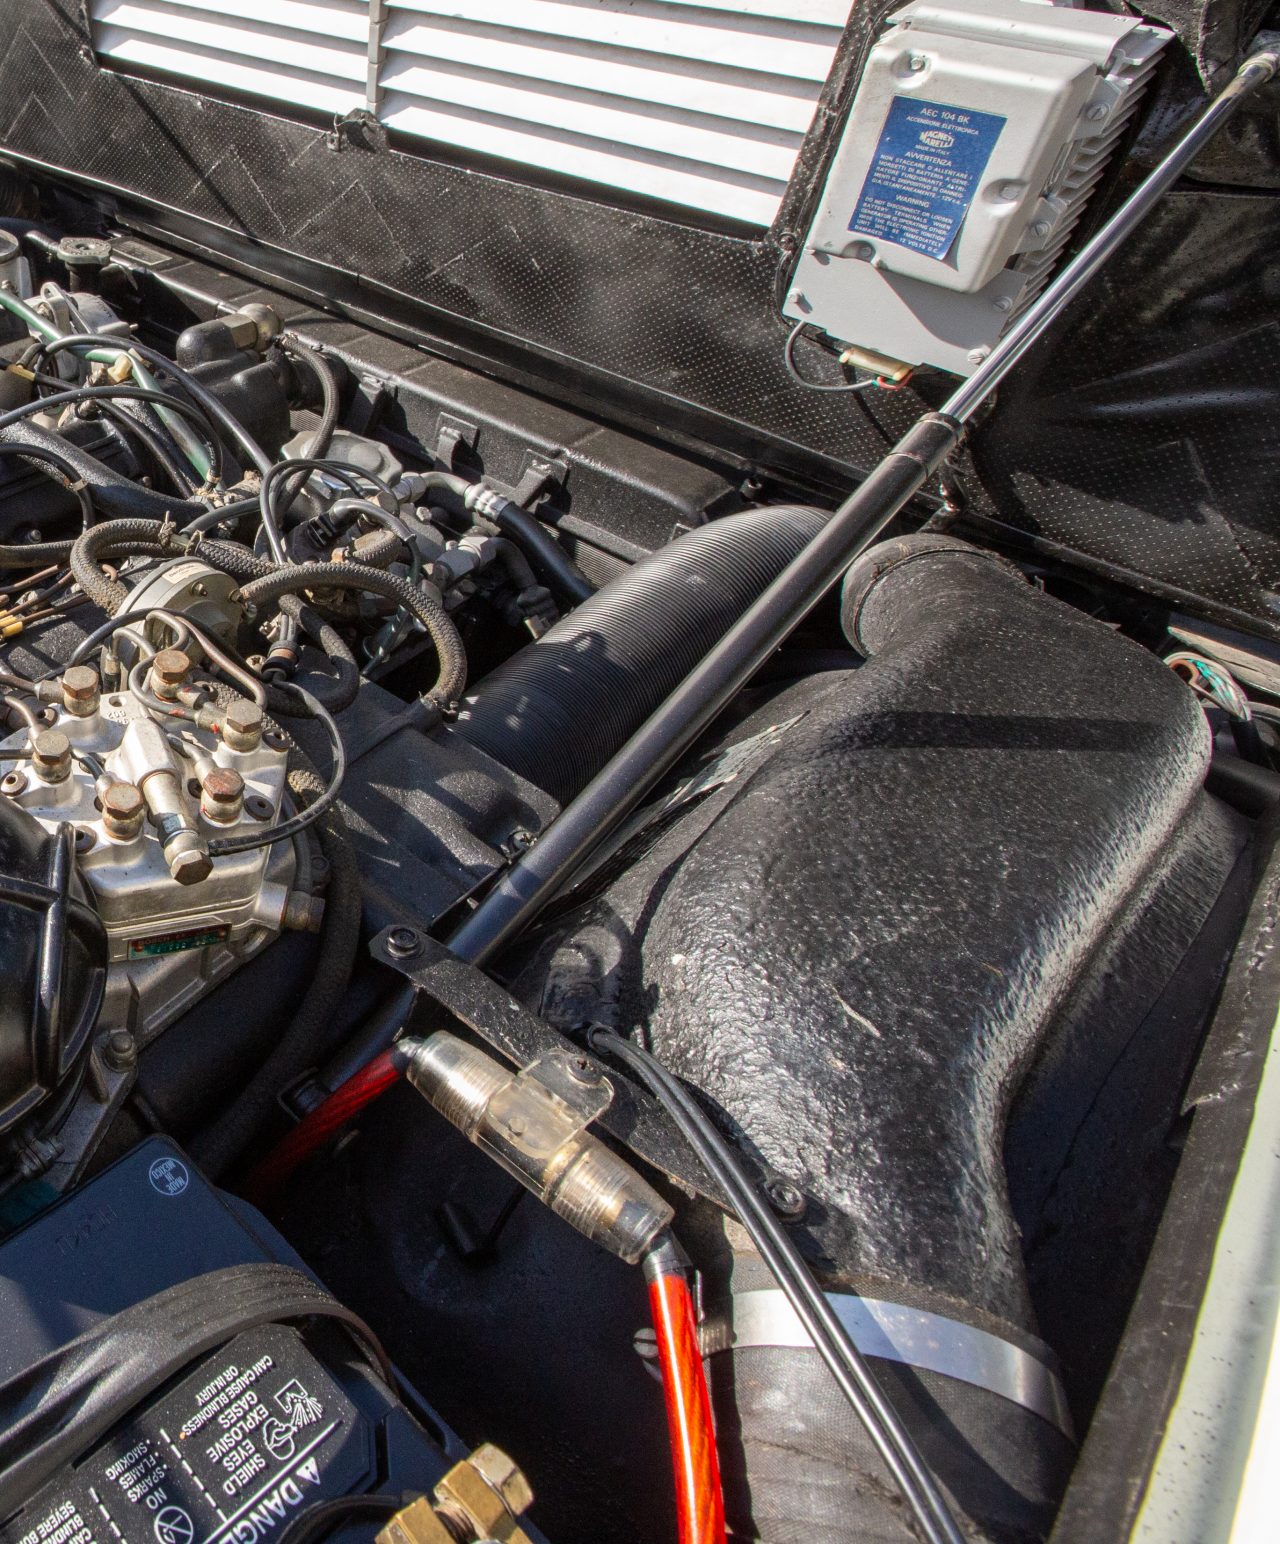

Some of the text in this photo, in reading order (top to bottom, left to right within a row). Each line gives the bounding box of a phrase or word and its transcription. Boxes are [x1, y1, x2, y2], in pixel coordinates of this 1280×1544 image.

[906, 115, 978, 135] ACCENSIONE ELETTRONICA
[920, 107, 970, 123] AEC 104 BK
[876, 166, 899, 175] RATORE
[878, 160, 906, 171] MORSETTI
[915, 168, 943, 179] BATTERIA
[895, 157, 925, 168] STACCARE
[933, 166, 967, 179] ALLENTARE
[904, 151, 952, 166] AVVERTENZA
[873, 172, 890, 180] MENTI
[897, 178, 931, 190] DISPOSITIVO
[882, 180, 935, 197] ISTANTANEAMENTE
[886, 202, 920, 215] DISCONNECT
[930, 214, 952, 224] LOOSEN
[895, 194, 929, 208] WARNING
[858, 213, 872, 221] WISE
[886, 221, 919, 233] ELECTRONIC
[920, 230, 945, 242] IGNITION
[860, 207, 891, 219] GENERATOR
[898, 218, 927, 230] OPERATING
[862, 202, 950, 229] BATTERY TERMINALS WHEN
[854, 225, 882, 236] DAMAGED
[907, 239, 926, 249] VOLTS
[874, 223, 888, 231] WILL
[903, 232, 942, 247] IMMEDIATELY
[152, 1159, 176, 1179] MEXICO
[164, 1172, 175, 1182] IN
[166, 1176, 185, 1193] MADE
[181, 1354, 273, 1435] CAN CAUSE BLINDNESS
[193, 1364, 239, 1405] OR INJURY
[216, 1389, 258, 1428] GASES
[205, 1403, 269, 1462] EXPLOSIVE
[104, 1441, 147, 1480] SMOKING
[221, 1438, 255, 1471] EYES
[117, 1454, 156, 1489] FLAMES
[221, 1452, 266, 1496] SHIELD
[125, 1466, 165, 1502] SPARKS
[144, 1487, 167, 1511] NO
[19, 1501, 75, 1544] SEVERE BU
[42, 1513, 84, 1544] BLINDN
